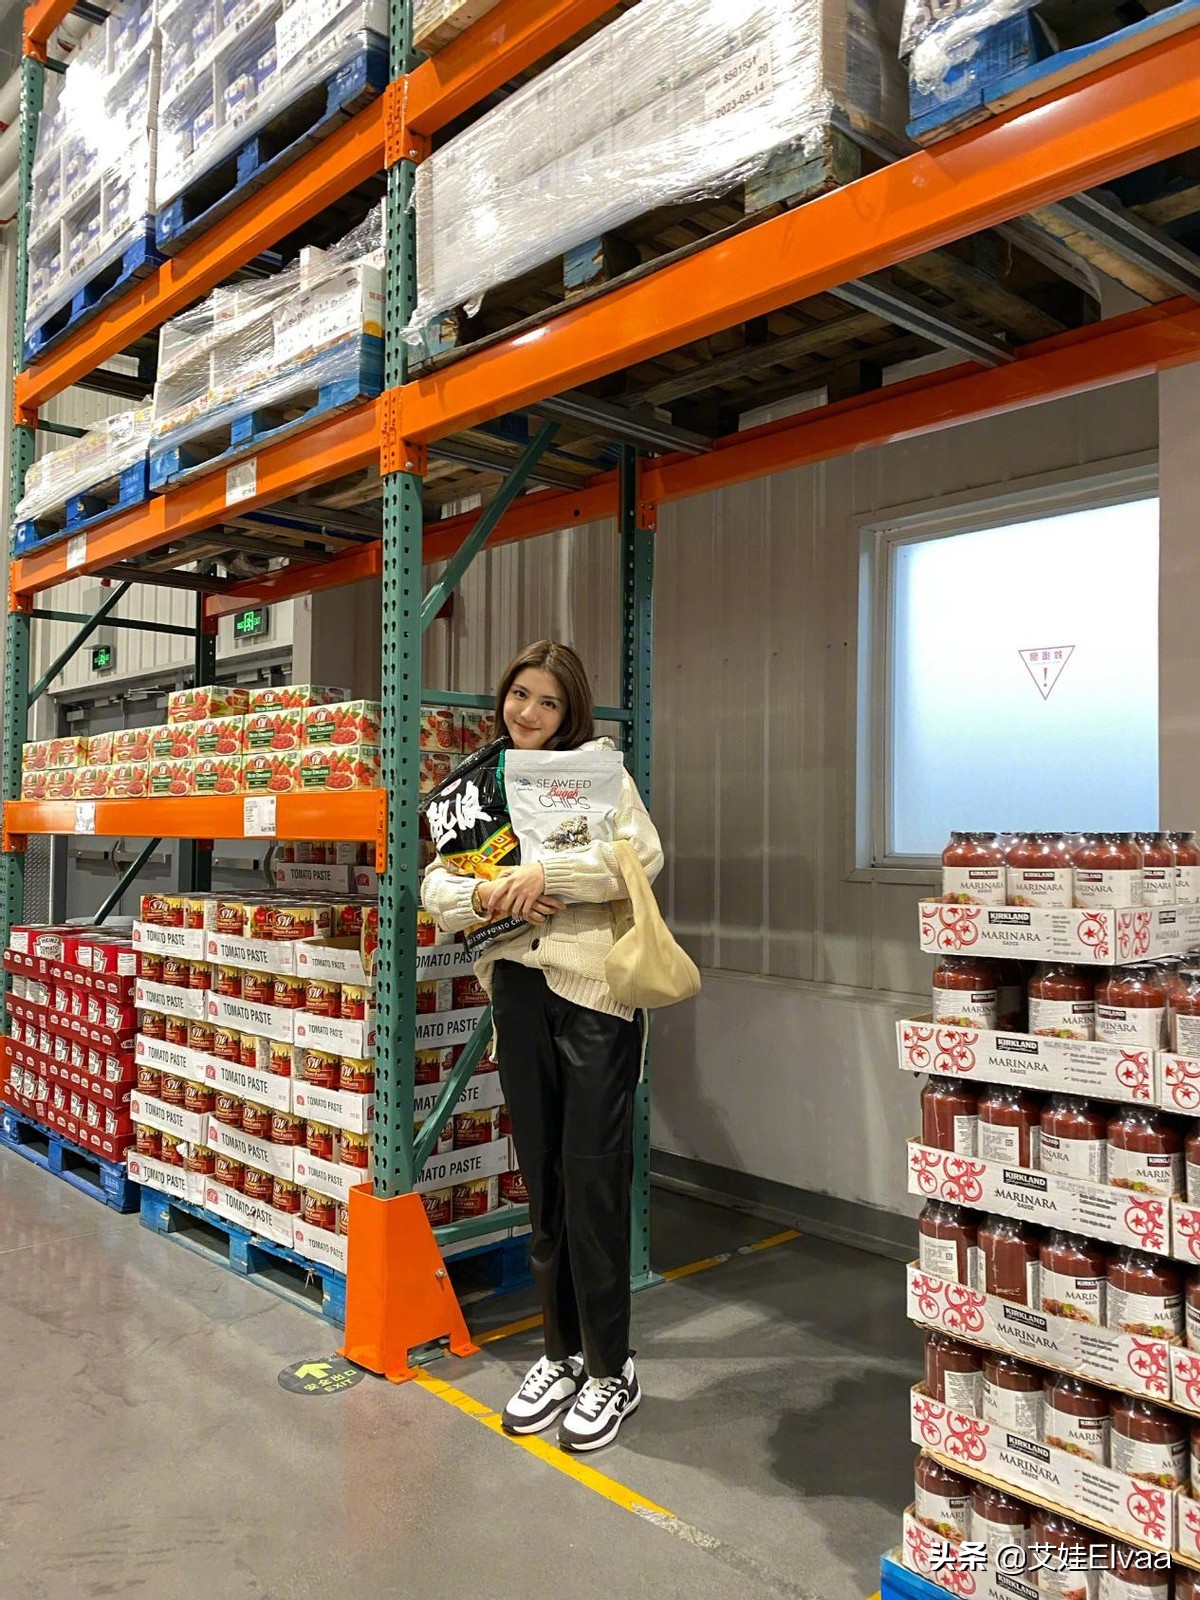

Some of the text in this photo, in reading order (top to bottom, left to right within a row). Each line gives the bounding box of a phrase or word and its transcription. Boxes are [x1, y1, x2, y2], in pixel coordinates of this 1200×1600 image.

[715, 82, 765, 118] 2023-05-14
[536, 779, 592, 789] SEAWEED
[538, 794, 591, 809] CHIPS
[291, 869, 331, 881] TOMATO PASTE
[960, 882, 1004, 890] MARINARA
[1143, 882, 1172, 890] RINARA
[510, 916, 523, 926] CHI
[990, 912, 1029, 921] KIRKLAND
[146, 930, 185, 946] TOMATO PASTE
[981, 930, 1041, 942] MARINARA
[221, 944, 268, 963] TOMATO PASTE
[453, 949, 484, 965] PASTE
[312, 958, 346, 970] TOMATO PASTE
[146, 990, 184, 1008] TOMATO PASTE
[223, 1003, 272, 1025] TOMATO PASTE
[1062, 1016, 1093, 1025] MARIN
[308, 1024, 343, 1038] TOMATO PASTE
[415, 1018, 478, 1039] MATO PASTE
[998, 1038, 1037, 1050] KIRKLAND
[148, 1046, 187, 1068] TOMATO PASTE
[988, 1057, 1049, 1072] MARINARA
[221, 1068, 268, 1094] TOMATO PASTE
[306, 1096, 342, 1114] TOMATO PASTE
[414, 1087, 479, 1111] MAT STE
[145, 1102, 184, 1127] TOMATO PASTE
[222, 1132, 269, 1162] TOMATO PASTE
[144, 1166, 185, 1190] TOMATO PASTE
[308, 1166, 343, 1186] TOMATO PASTE
[414, 1156, 482, 1184] MATO PASTE
[1136, 1170, 1171, 1178] MARIN
[1005, 1172, 1046, 1186] KIRKLAND
[994, 1188, 1057, 1210] MARINARA
[1017, 1202, 1034, 1210] SAUCE
[308, 1238, 344, 1260] TOMATO PASTE
[1066, 1292, 1098, 1300] MARIN
[1006, 1307, 1046, 1326] KIRKLAND
[998, 1324, 1058, 1350] MARINARA
[1019, 1339, 1036, 1348] SAUCE
[303, 1369, 358, 1392] 安全出口
[324, 1378, 353, 1392] EXIT
[1068, 1430, 1102, 1440] MARIN
[1008, 1436, 1049, 1458] KIRKLAND
[1000, 1452, 1060, 1485] MARINARA
[1021, 1470, 1039, 1480] SAUCE
[941, 1510, 965, 1519] MARI
[999, 1576, 1038, 1598] KIRKLAND
